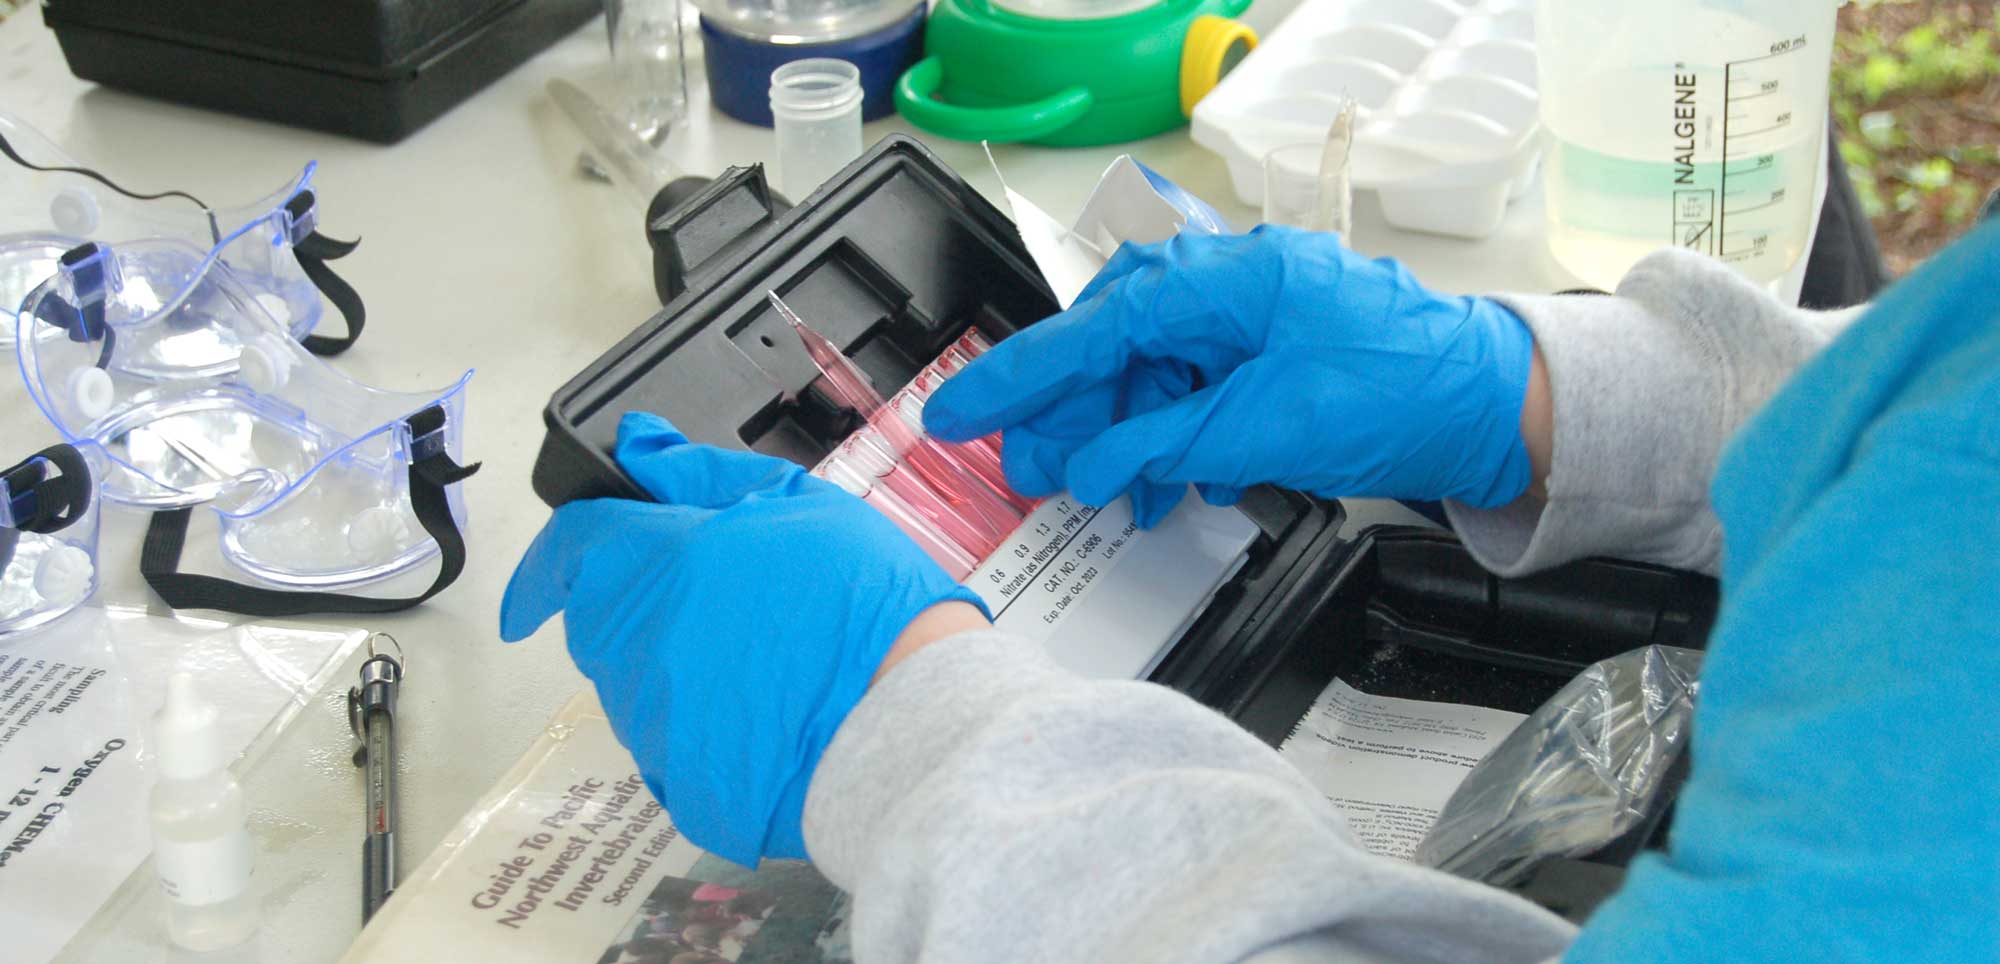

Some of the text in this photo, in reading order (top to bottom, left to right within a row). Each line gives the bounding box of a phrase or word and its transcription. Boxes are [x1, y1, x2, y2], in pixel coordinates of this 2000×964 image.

[1770, 39, 1790, 54] 600
[1760, 80, 1779, 91] 500
[1776, 112, 1792, 123] 400
[1674, 73, 1696, 184] NALGENE
[1758, 154, 1774, 166] 300
[1753, 234, 1768, 248] 100
[989, 501, 1071, 584] 0.6 0.9 1.3 1.7
[1000, 573, 1027, 598] Nitrate
[1022, 562, 1038, 577] (as
[1062, 514, 1082, 534] PPM
[1101, 547, 1116, 560] Lot
[1043, 574, 1066, 593] CAT.
[1043, 610, 1062, 624] Exp.
[1055, 595, 1075, 611] Date:
[62, 666, 86, 681] The
[30, 683, 45, 692] to
[43, 681, 67, 700] most
[47, 668, 107, 714] Sampling
[4, 692, 33, 716] obtain
[17, 700, 47, 727] critical
[39, 765, 62, 774] 1
[56, 738, 126, 798] Oxygen
[8, 788, 40, 807] 12
[470, 776, 605, 910] Guide To Pacific
[495, 773, 644, 930] Northwest Aquatic
[553, 800, 665, 912] Invertebrates
[602, 857, 653, 907] Second
